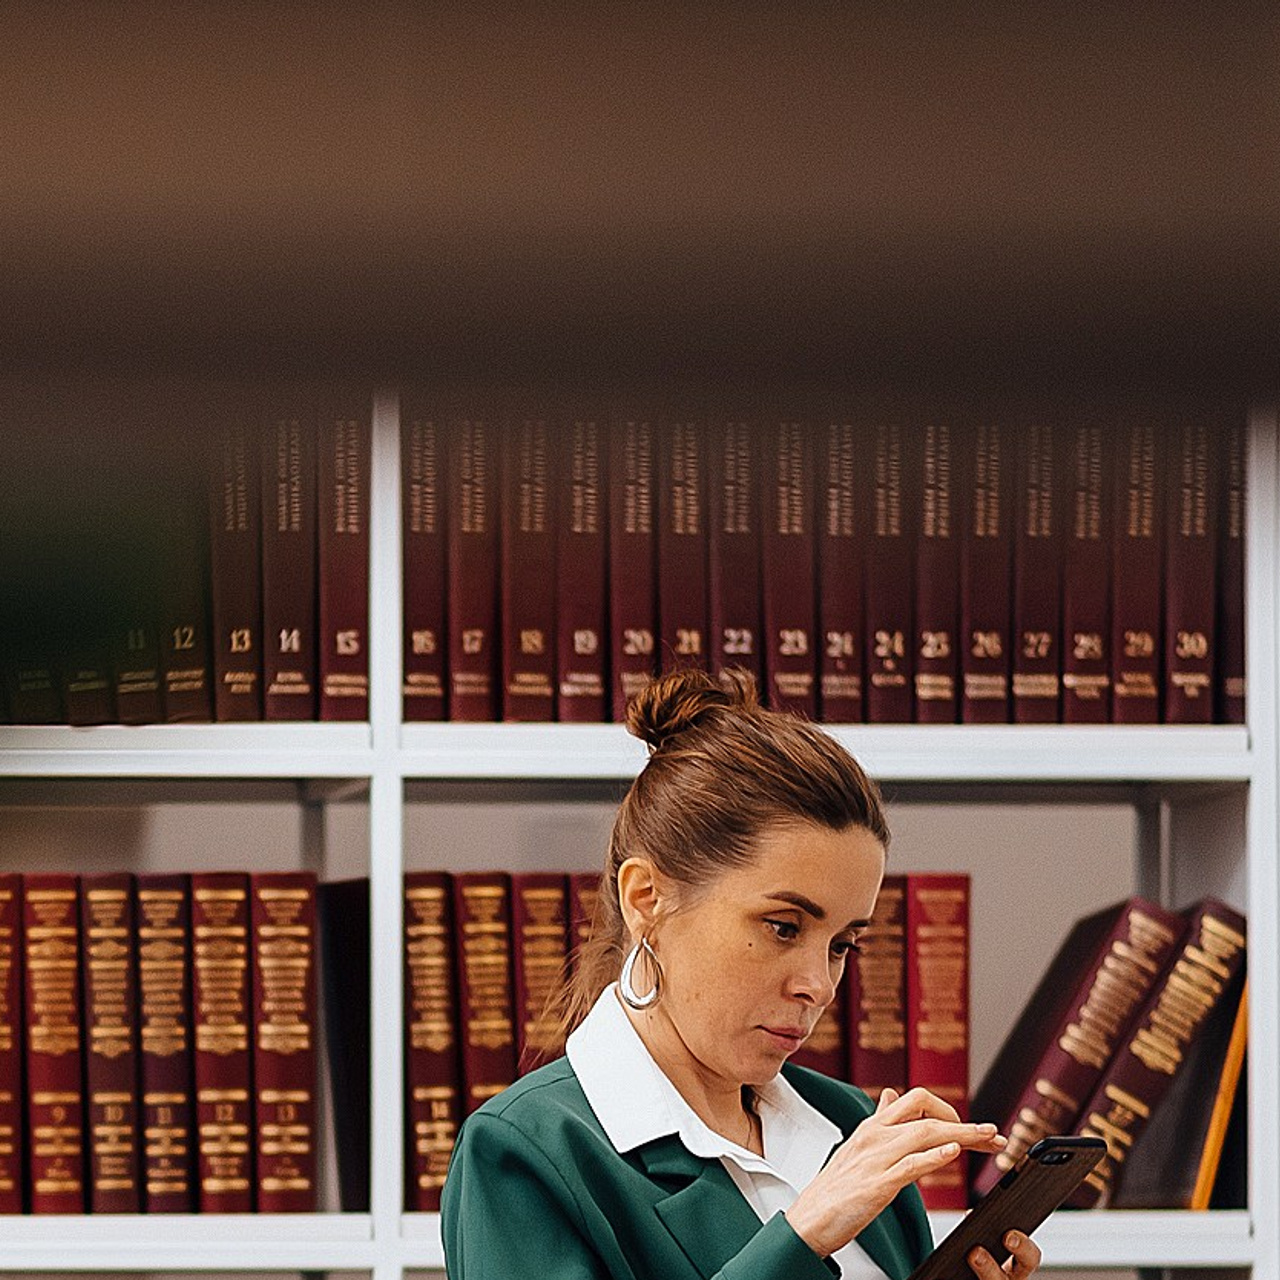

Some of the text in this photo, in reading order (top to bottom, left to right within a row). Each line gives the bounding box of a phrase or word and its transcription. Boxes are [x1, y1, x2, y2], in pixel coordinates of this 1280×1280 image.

[173, 626, 195, 650] 12
[230, 629, 251, 652] 13
[279, 629, 301, 651] 14
[336, 629, 360, 654] 15
[623, 629, 655, 655] 20
[676, 629, 701, 655] 21
[723, 628, 754, 655] 22
[1023, 631, 1052, 658] 27
[1176, 631, 1208, 659] 30
[52, 1104, 66, 1122] 9
[104, 1104, 123, 1122] 10
[215, 1103, 234, 1122] 12
